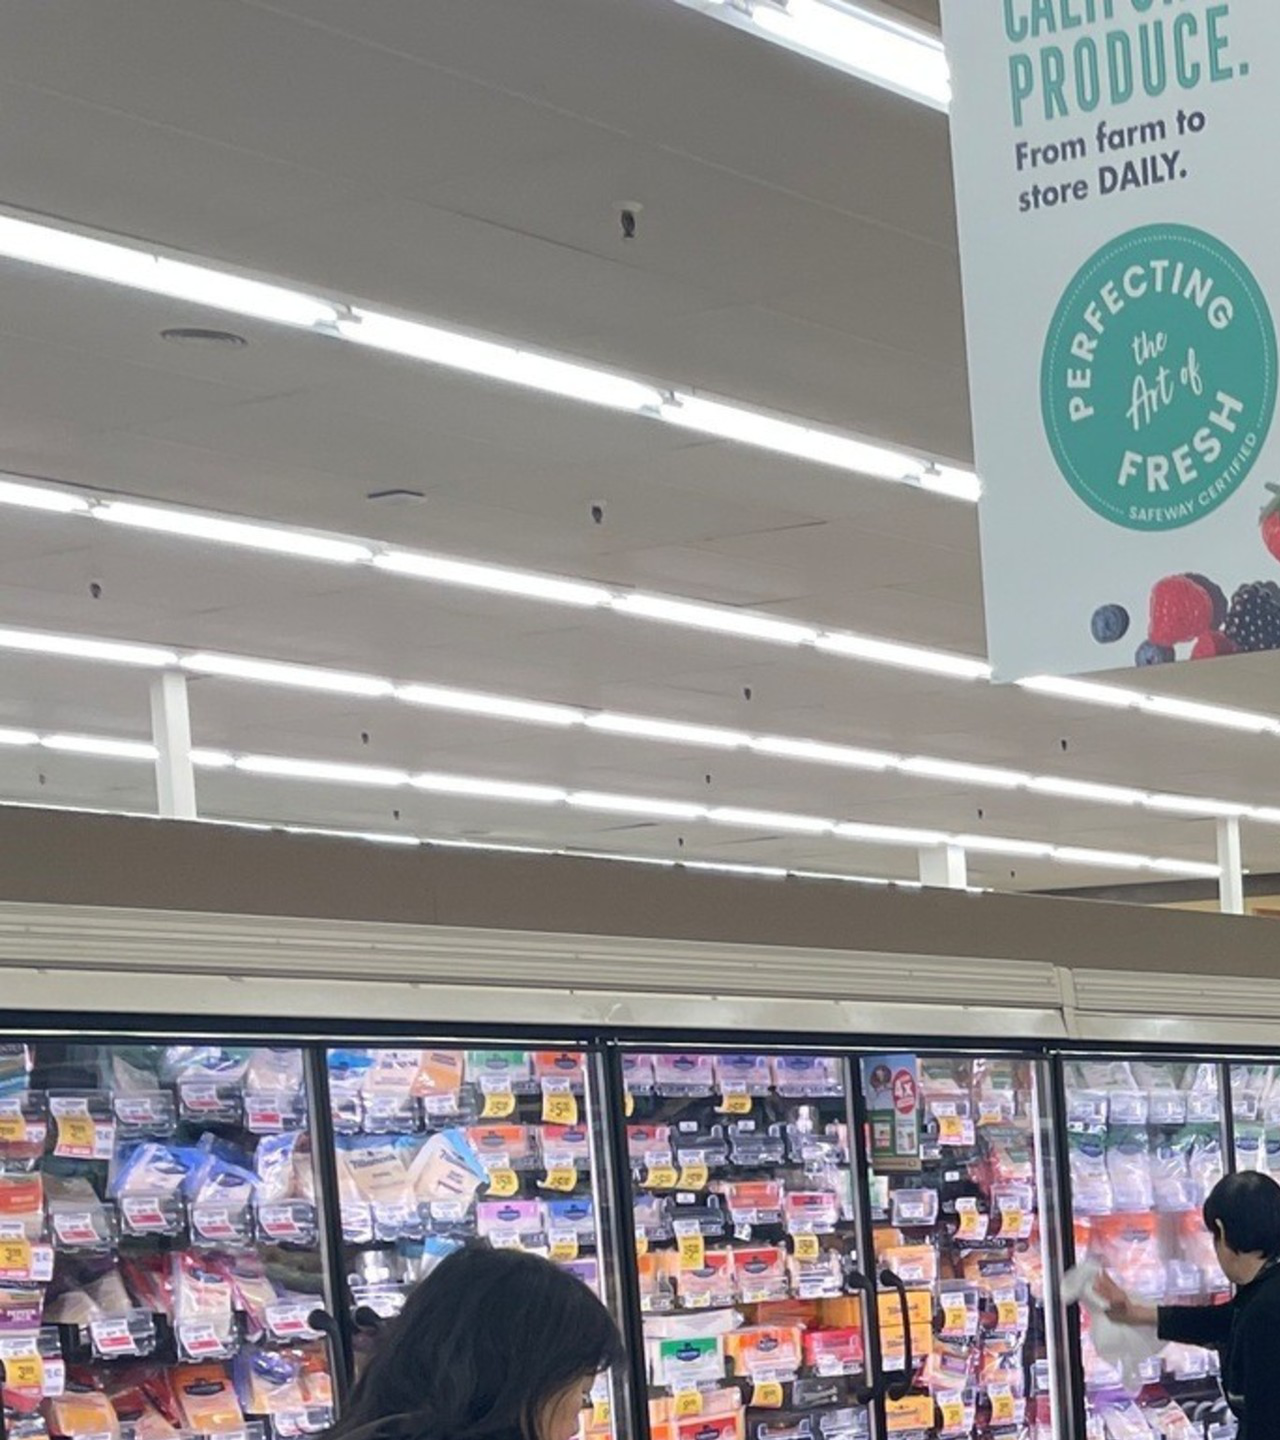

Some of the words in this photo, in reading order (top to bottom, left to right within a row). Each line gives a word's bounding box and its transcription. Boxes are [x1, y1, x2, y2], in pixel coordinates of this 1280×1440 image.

[1008, 4, 1250, 127] PRODUCE.
[1015, 134, 1086, 171] From
[1096, 119, 1167, 154] farm
[1176, 109, 1206, 136] to
[1018, 177, 1089, 213] store
[1100, 151, 1188, 195] DAILY.
[1067, 259, 1235, 422] PERFECTING
[1131, 329, 1168, 365] the
[1125, 367, 1174, 431] Art
[1180, 347, 1204, 396] of
[1118, 390, 1244, 493] FRESH
[1128, 500, 1195, 523] SAFEWAY
[1198, 432, 1258, 506] CERTIFIED
